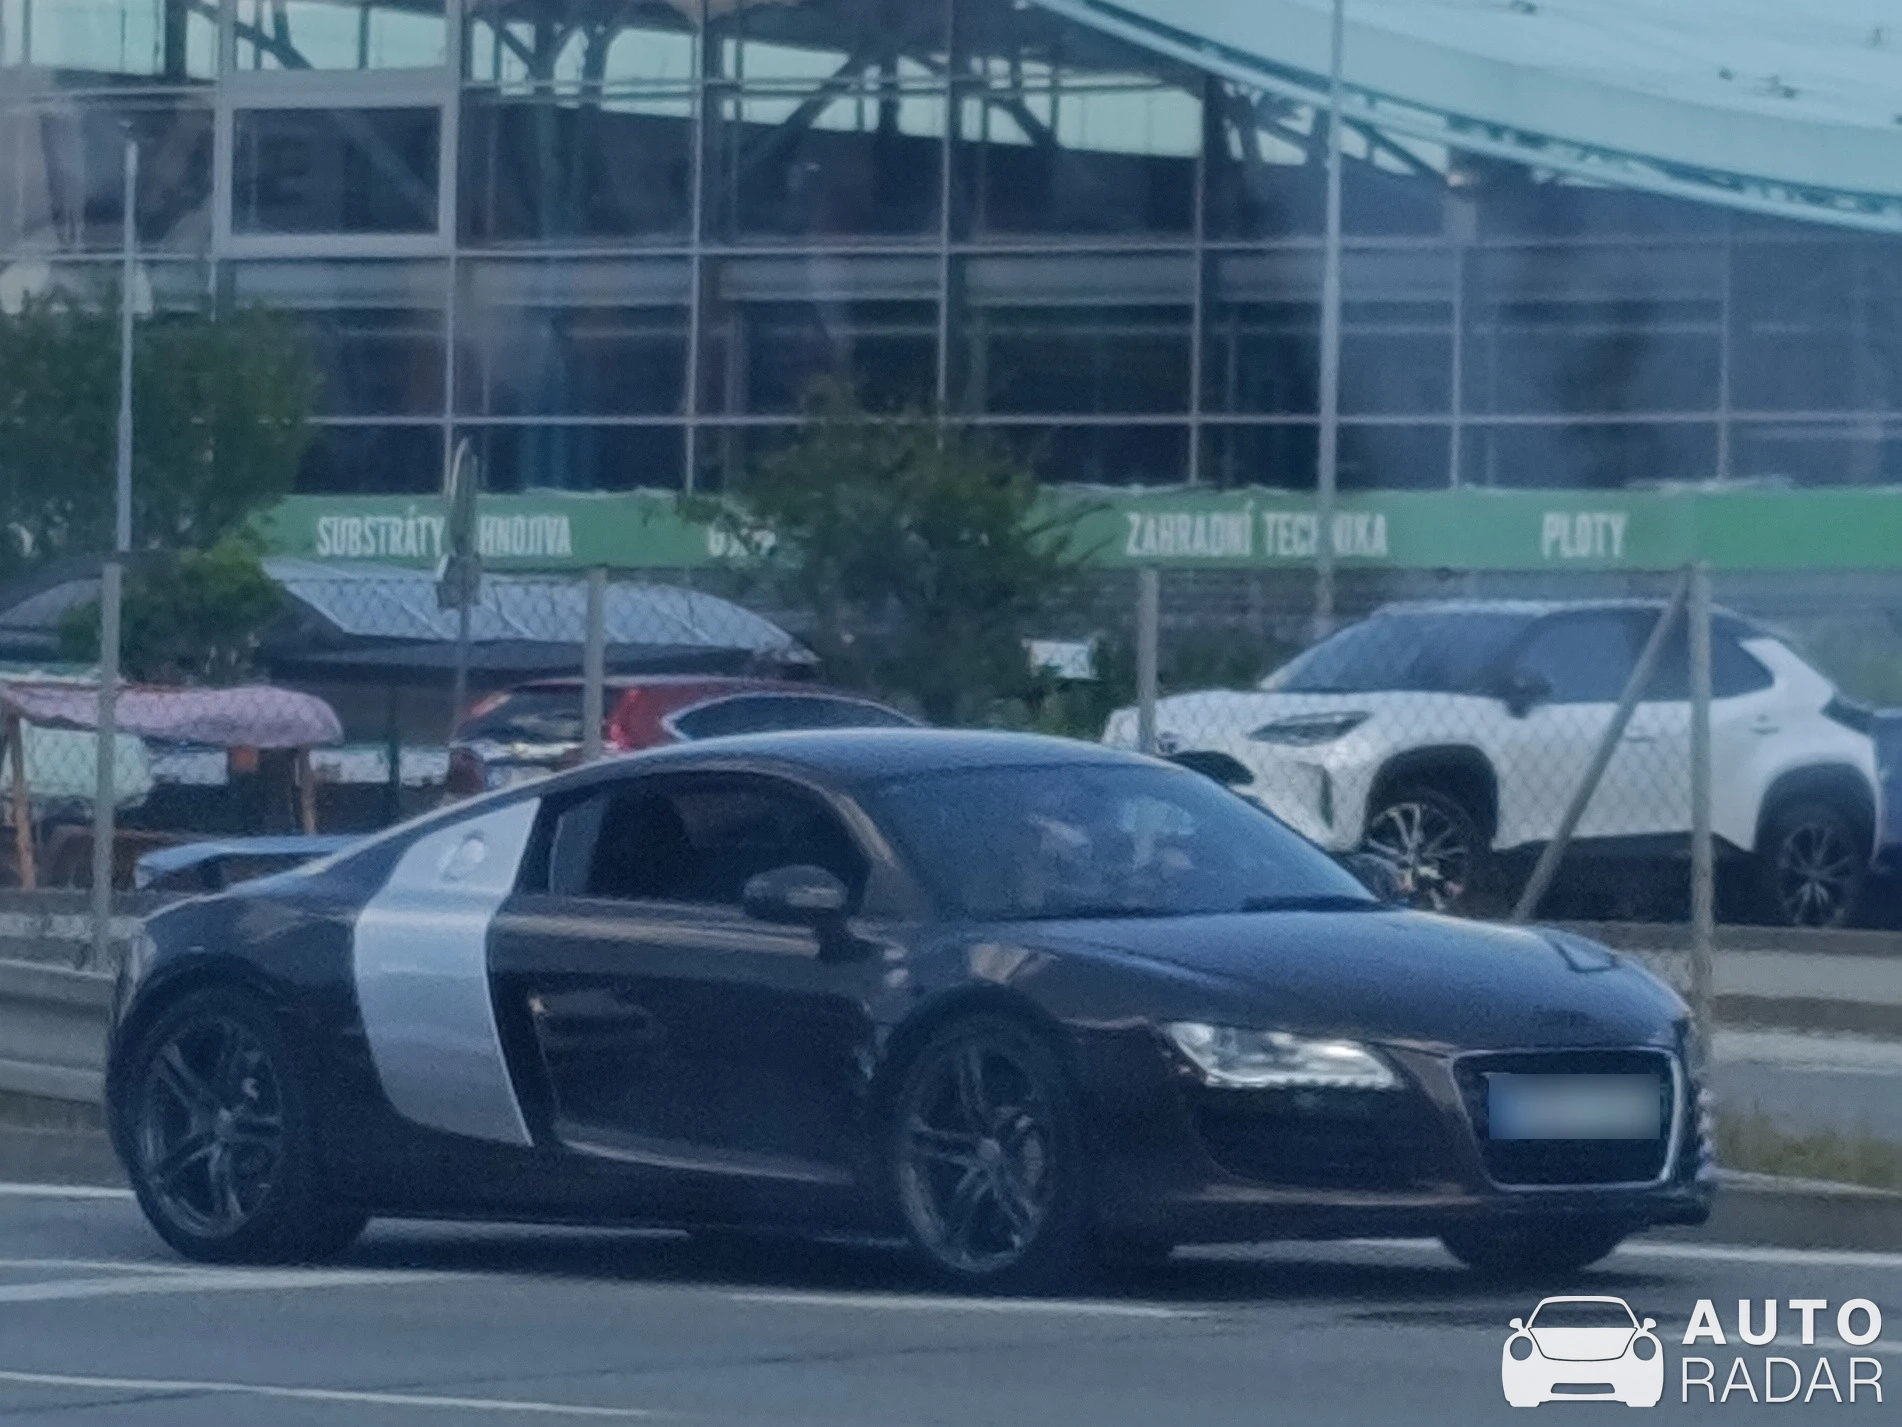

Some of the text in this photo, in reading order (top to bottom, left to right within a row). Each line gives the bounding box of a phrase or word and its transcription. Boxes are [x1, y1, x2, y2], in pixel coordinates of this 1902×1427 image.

[316, 505, 573, 557] SUBSTRÁTY HNOJIVA
[1126, 500, 1253, 557] ZAHRADNÍ
[1542, 512, 1628, 558] PLOTY
